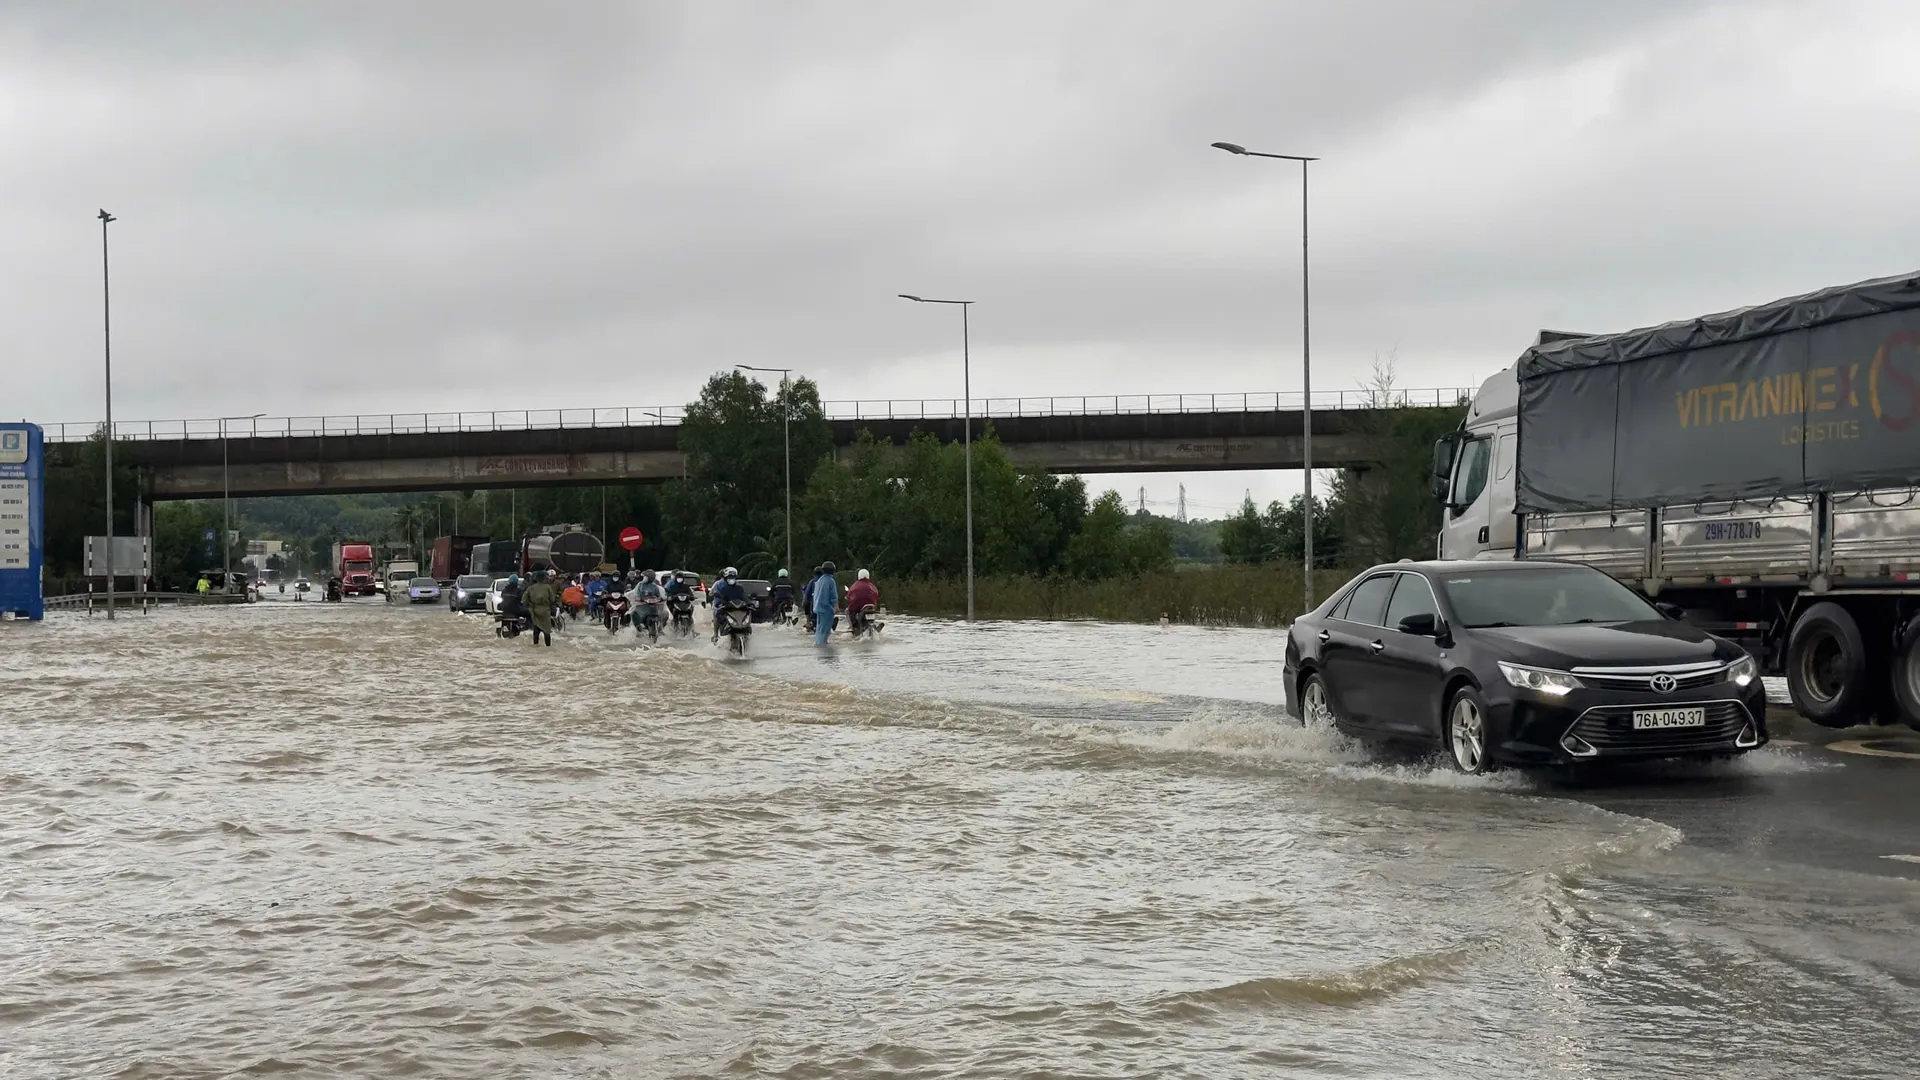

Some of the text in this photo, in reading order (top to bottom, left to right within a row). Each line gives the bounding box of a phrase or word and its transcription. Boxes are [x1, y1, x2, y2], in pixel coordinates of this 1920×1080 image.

[1676, 363, 1859, 428] VITRANIMEX
[1780, 420, 1860, 445] LOGISTICS
[1705, 521, 1761, 540] 29H-778.78
[1636, 710, 1702, 728] 76A-049.37
